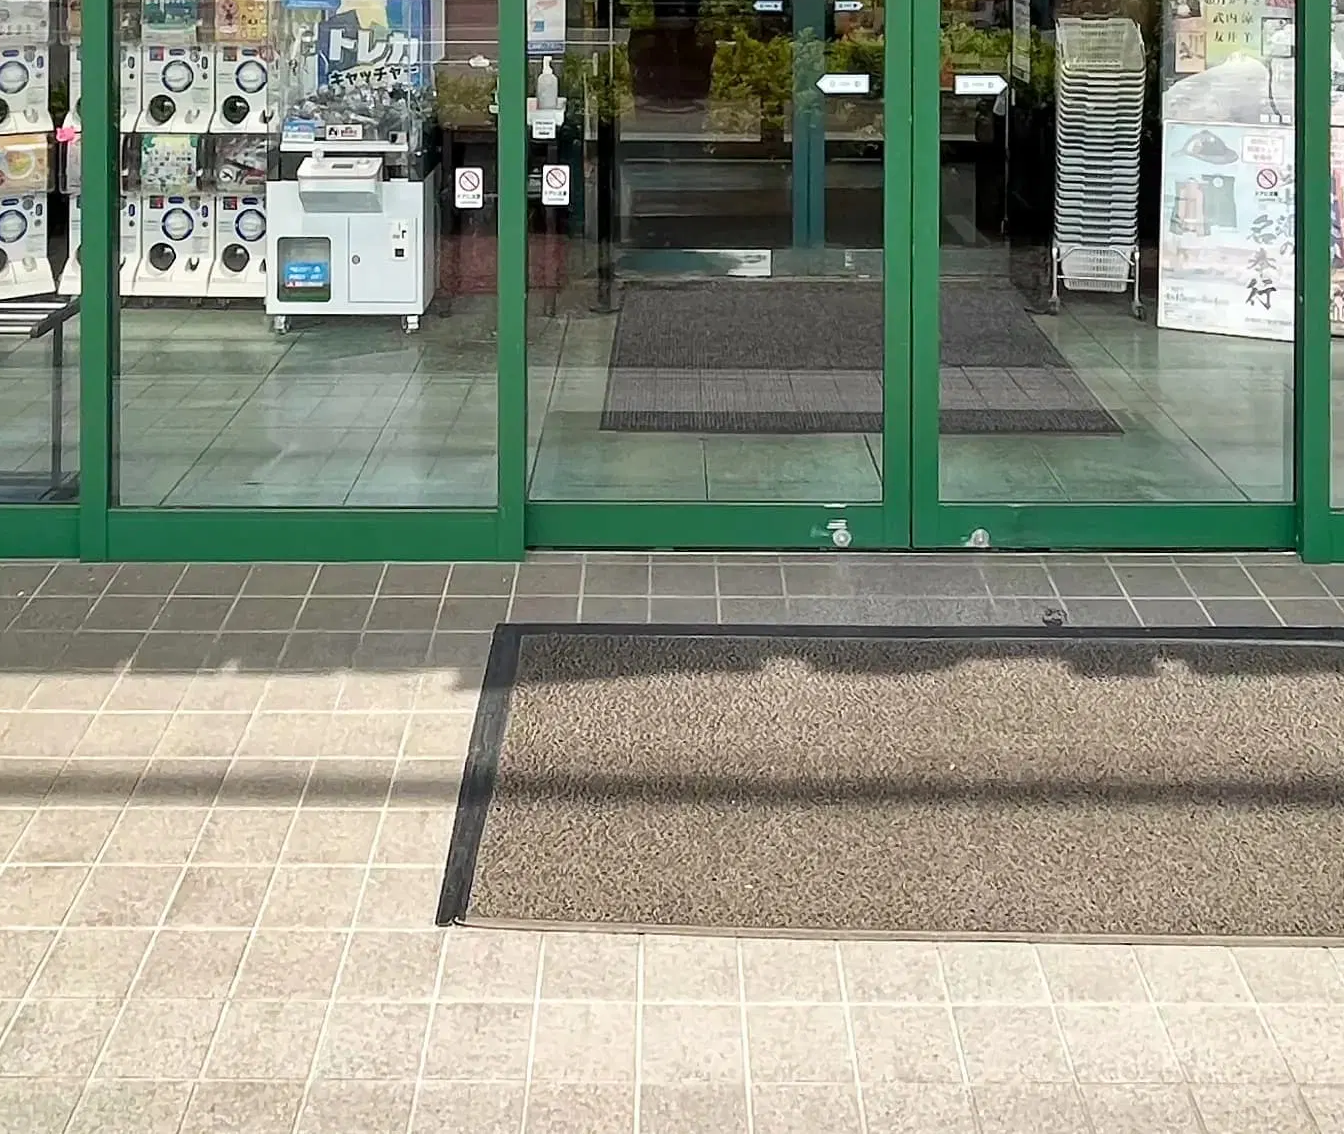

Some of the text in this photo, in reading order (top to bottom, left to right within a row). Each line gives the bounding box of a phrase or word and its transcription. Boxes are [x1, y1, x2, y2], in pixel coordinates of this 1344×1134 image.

[329, 29, 419, 66] トレカ
[328, 66, 420, 86] キャッチャー
